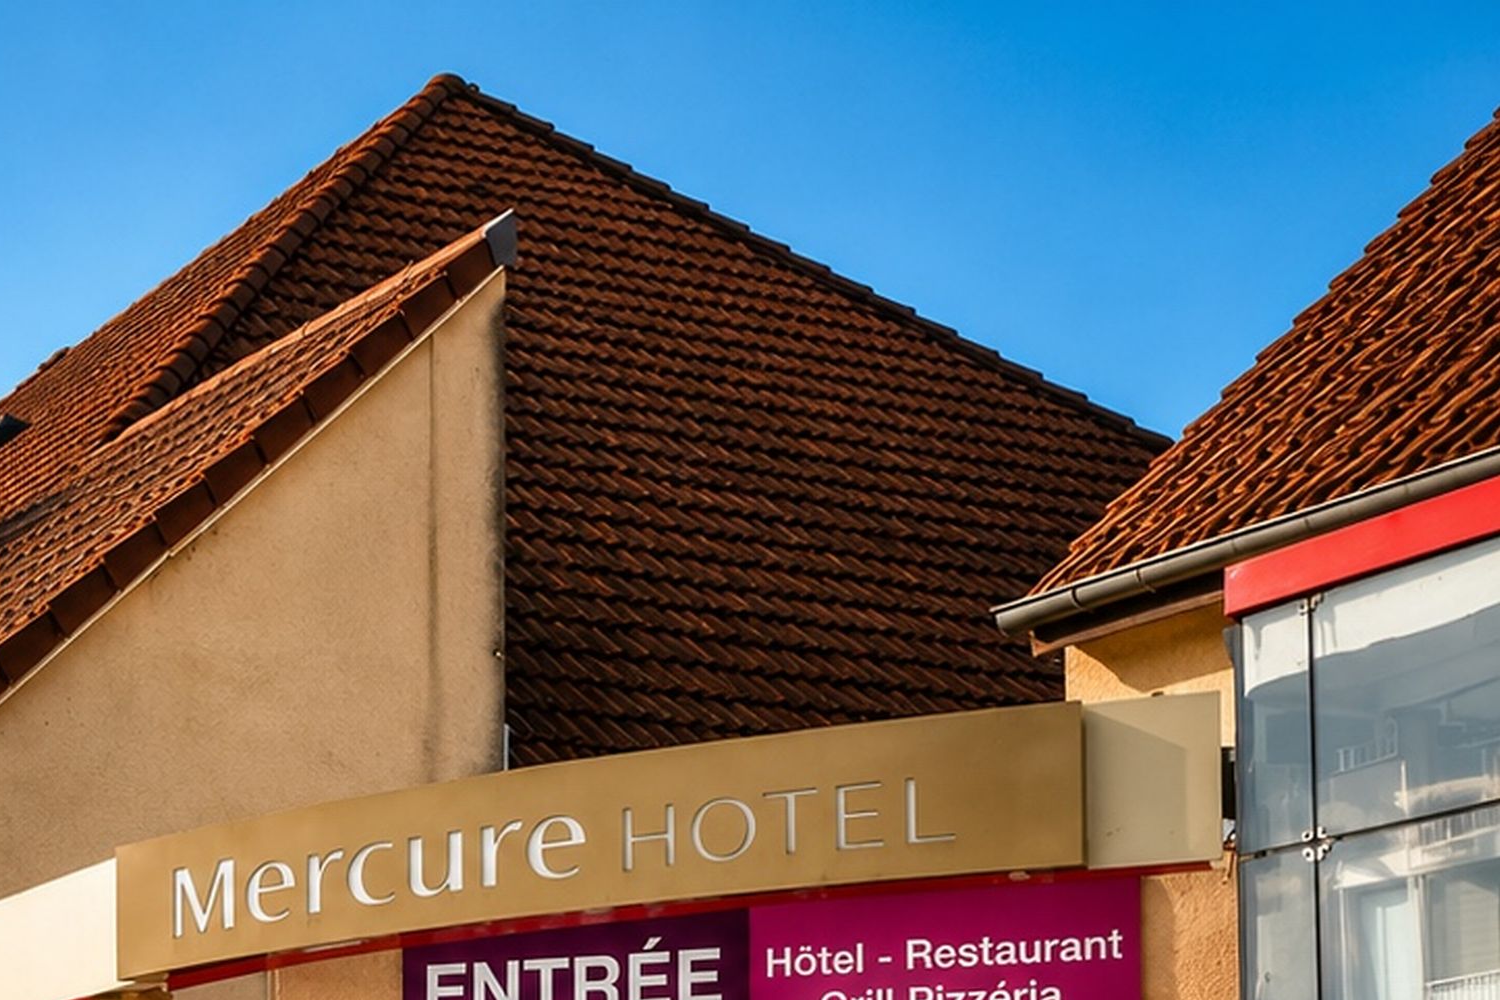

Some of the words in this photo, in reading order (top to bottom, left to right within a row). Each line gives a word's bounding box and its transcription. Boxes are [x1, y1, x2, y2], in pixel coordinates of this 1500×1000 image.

[173, 814, 587, 938] Mercure
[622, 777, 956, 872] HOTEL
[905, 929, 1123, 970] Restaurant
